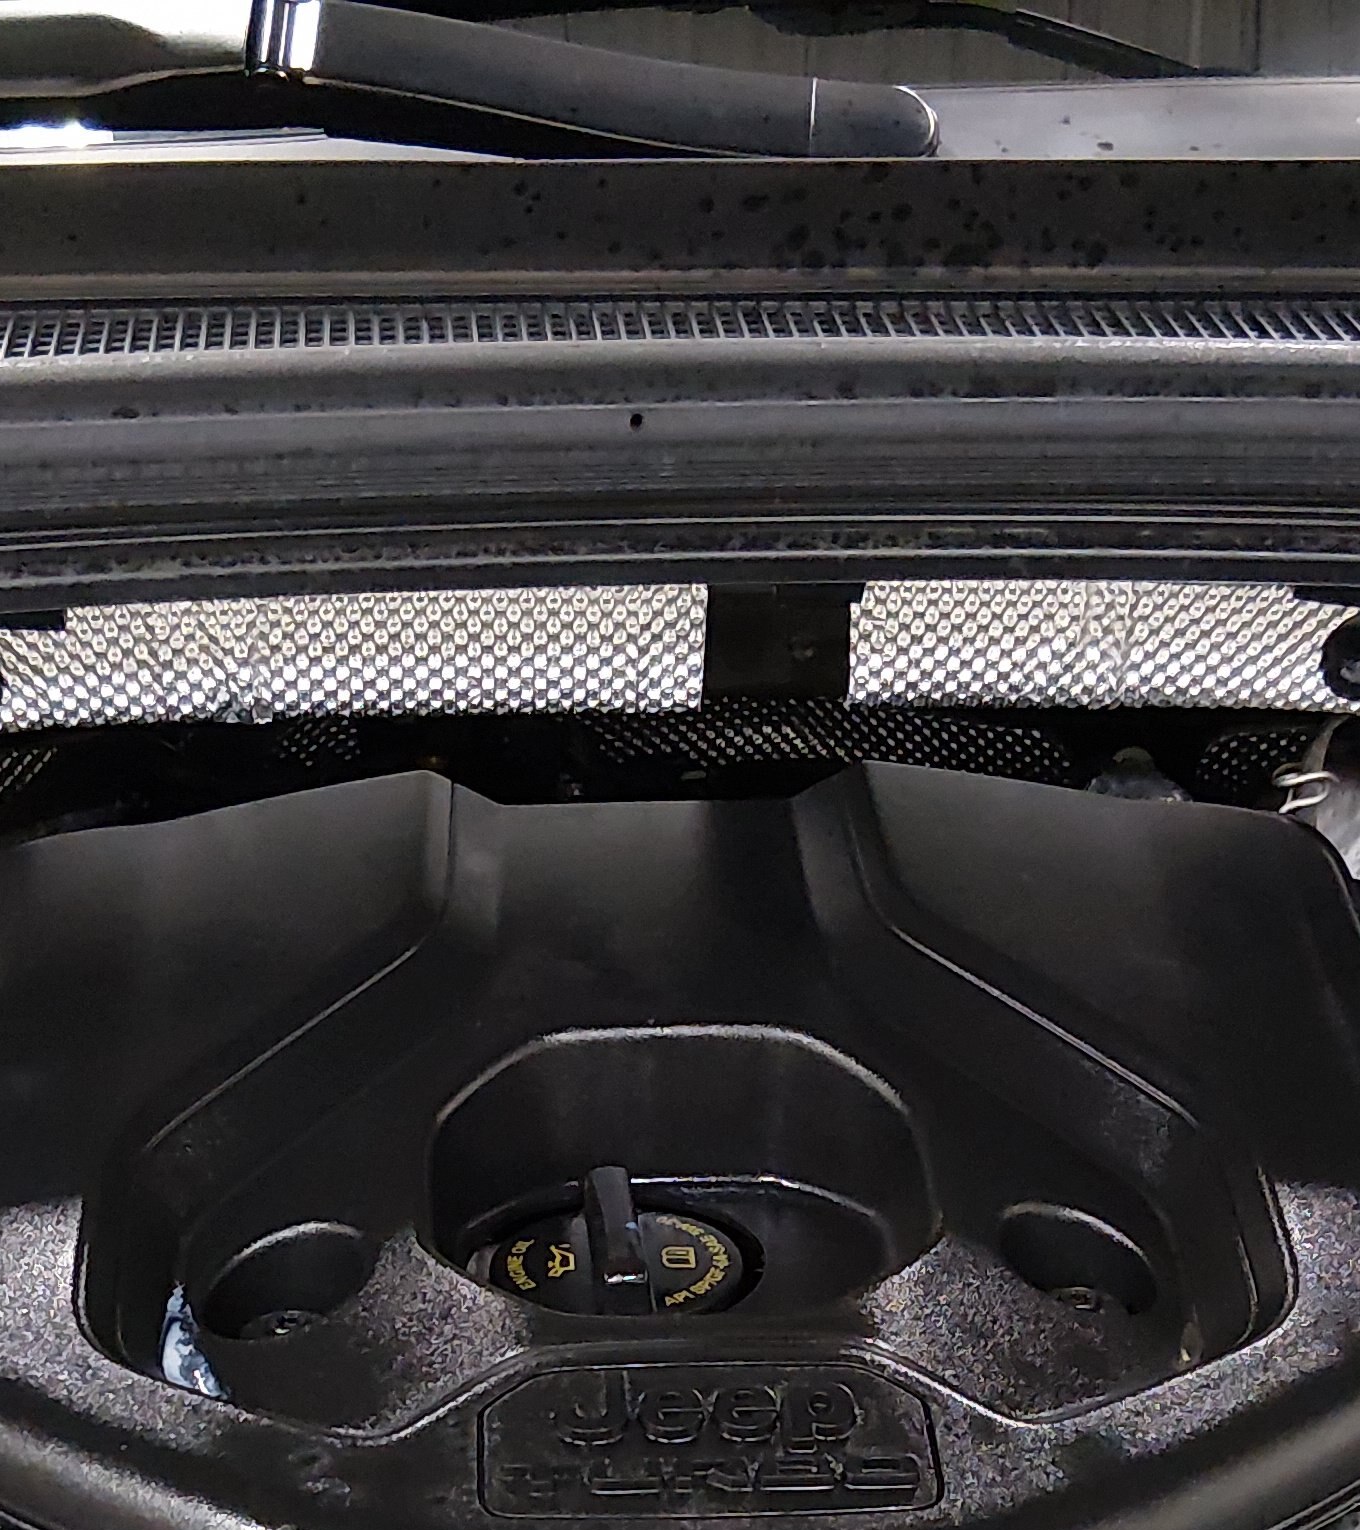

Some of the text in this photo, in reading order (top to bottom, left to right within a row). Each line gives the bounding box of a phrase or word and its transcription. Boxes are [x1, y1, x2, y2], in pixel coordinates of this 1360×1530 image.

[506, 1239, 537, 1291] ENGINE OIL
[664, 1289, 696, 1307] API
[550, 1369, 866, 1455] Jeep
[495, 1451, 923, 1500] TURBO
